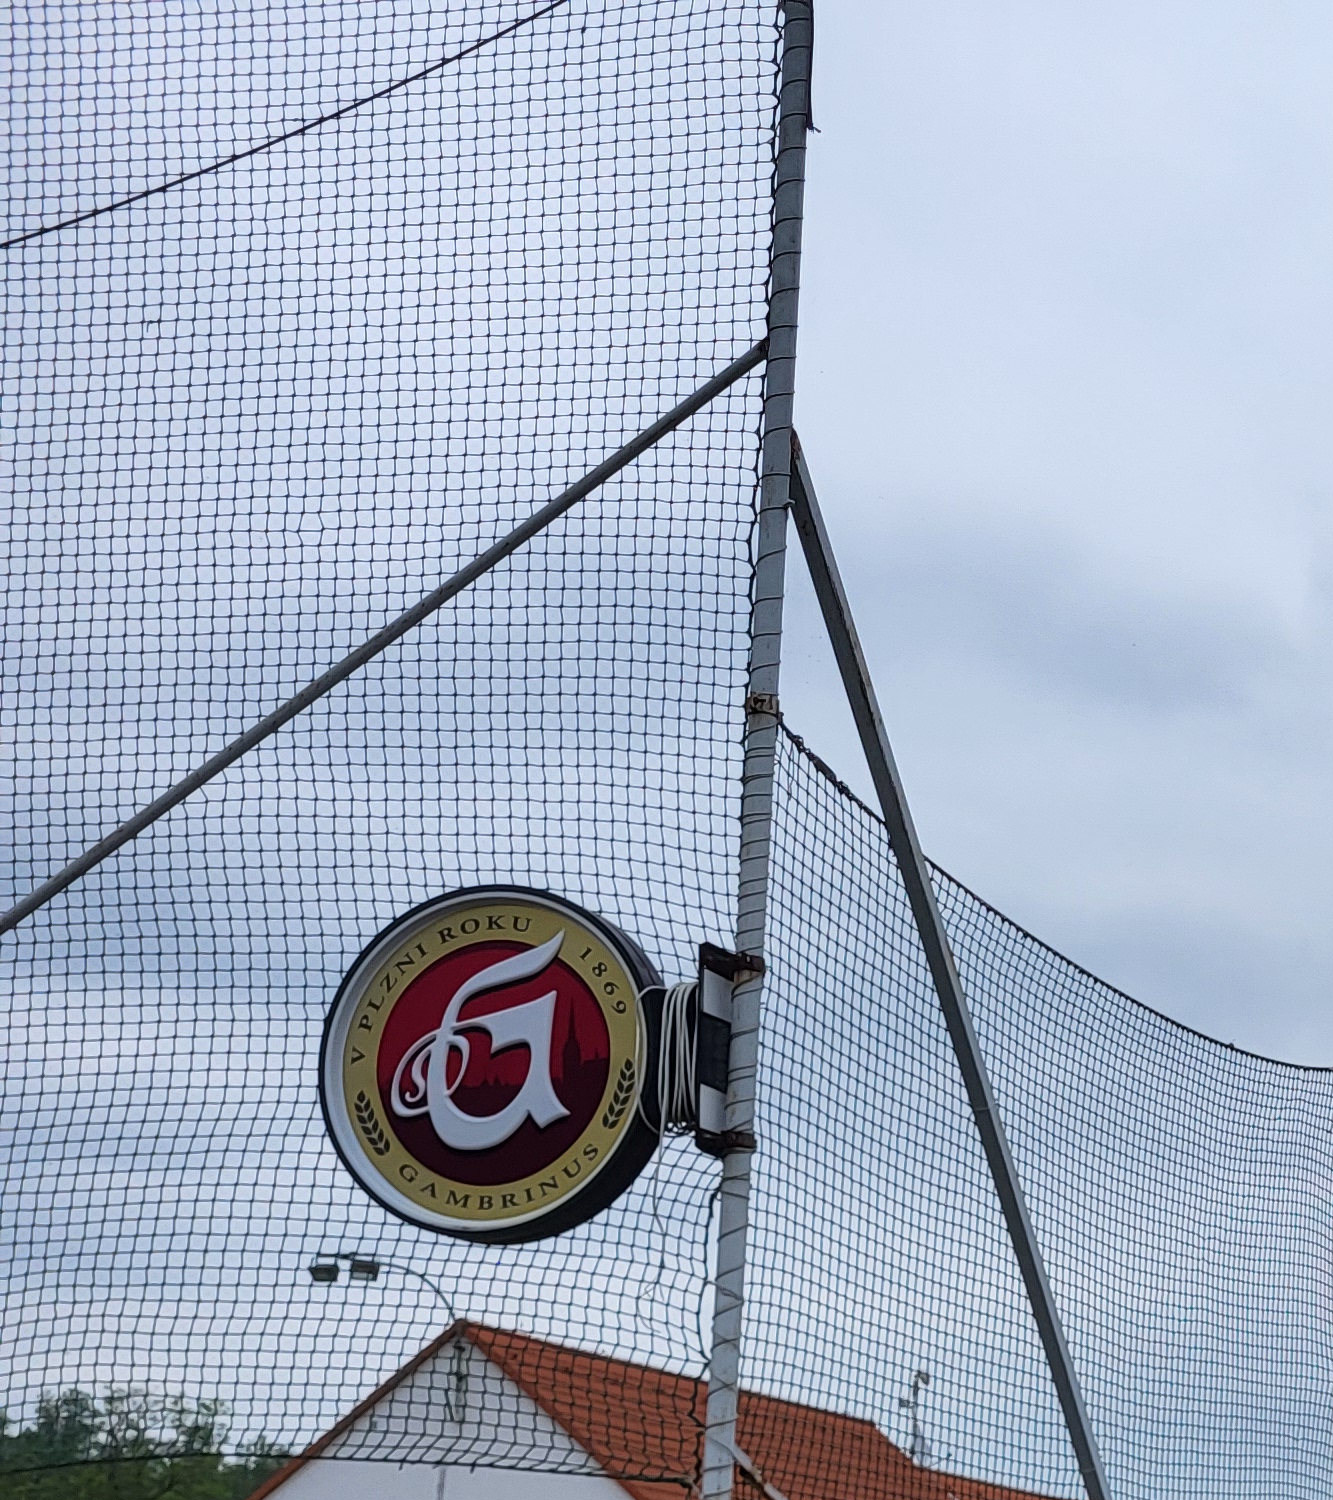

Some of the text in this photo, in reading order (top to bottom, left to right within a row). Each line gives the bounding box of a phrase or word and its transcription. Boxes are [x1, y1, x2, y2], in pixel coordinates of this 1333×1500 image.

[350, 914, 628, 1065] V PLZNI ROKU 1869
[398, 1142, 601, 1212] GAMBRINUS
